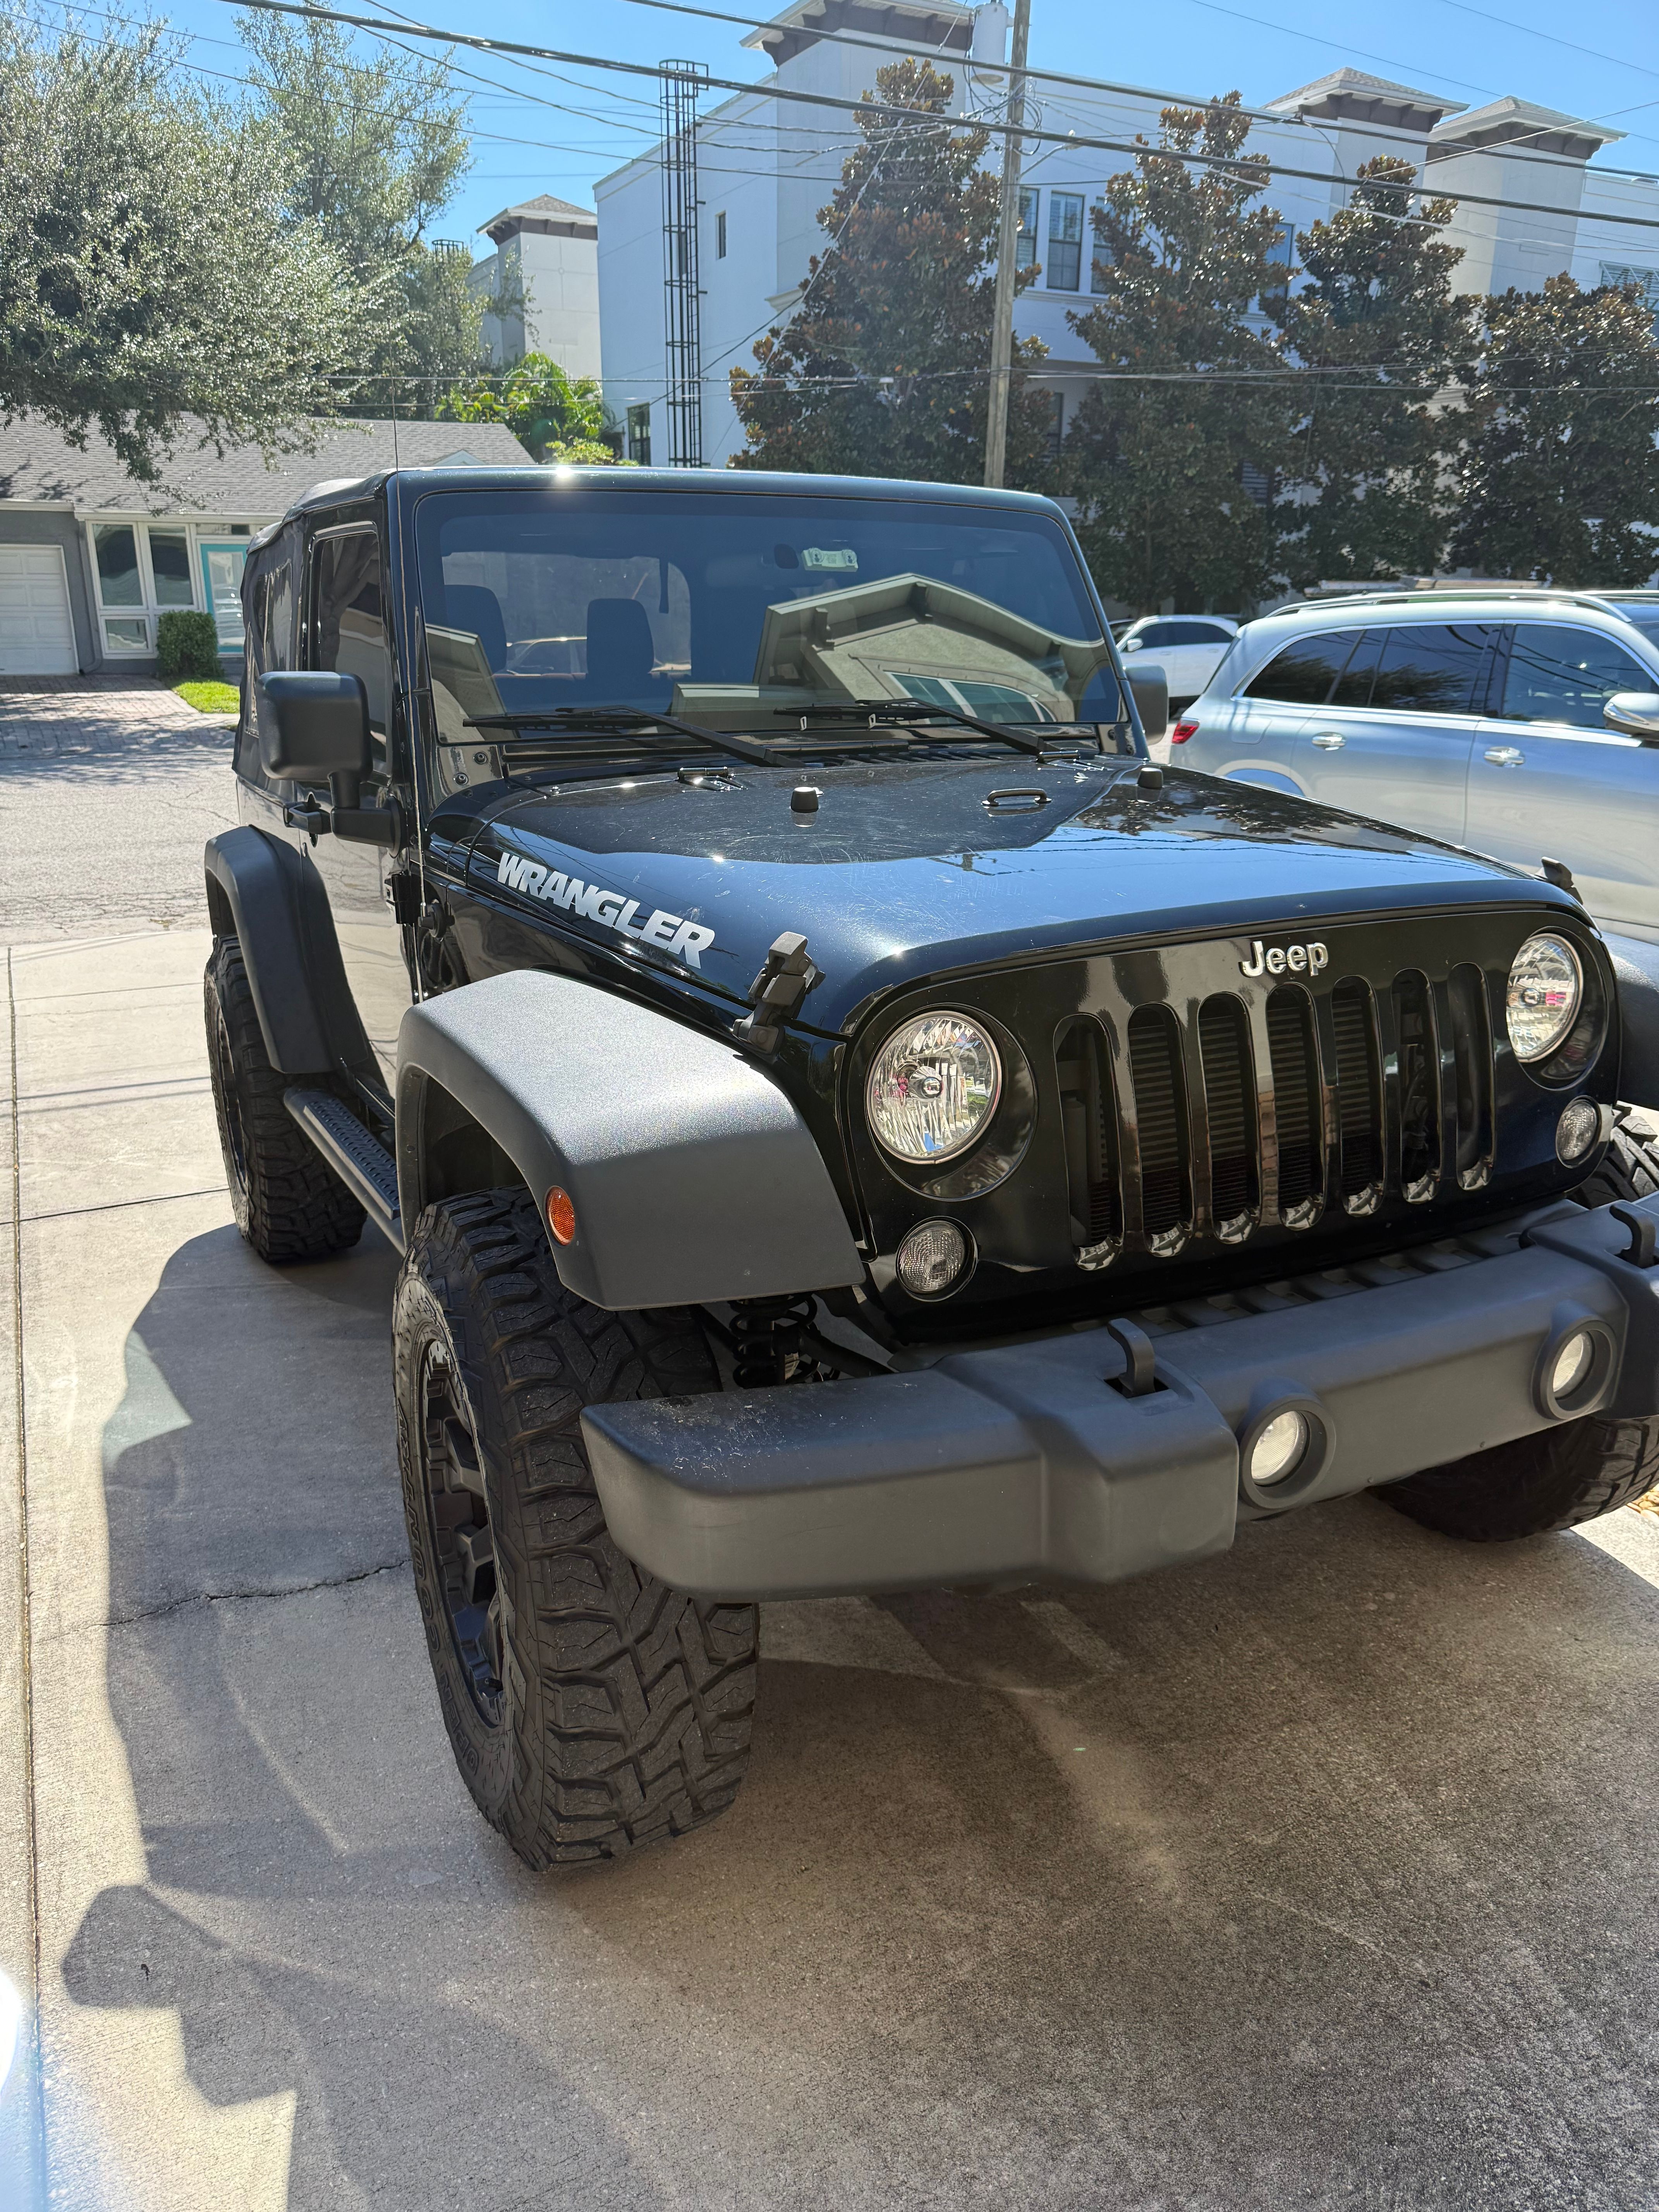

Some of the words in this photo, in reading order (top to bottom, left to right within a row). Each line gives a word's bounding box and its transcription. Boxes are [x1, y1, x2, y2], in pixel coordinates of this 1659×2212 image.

[498, 852, 715, 969] WRANGLER
[1239, 940, 1328, 977] Jeep
[397, 1397, 439, 1651] COUNTRY
[438, 1671, 479, 1776] OPEN
